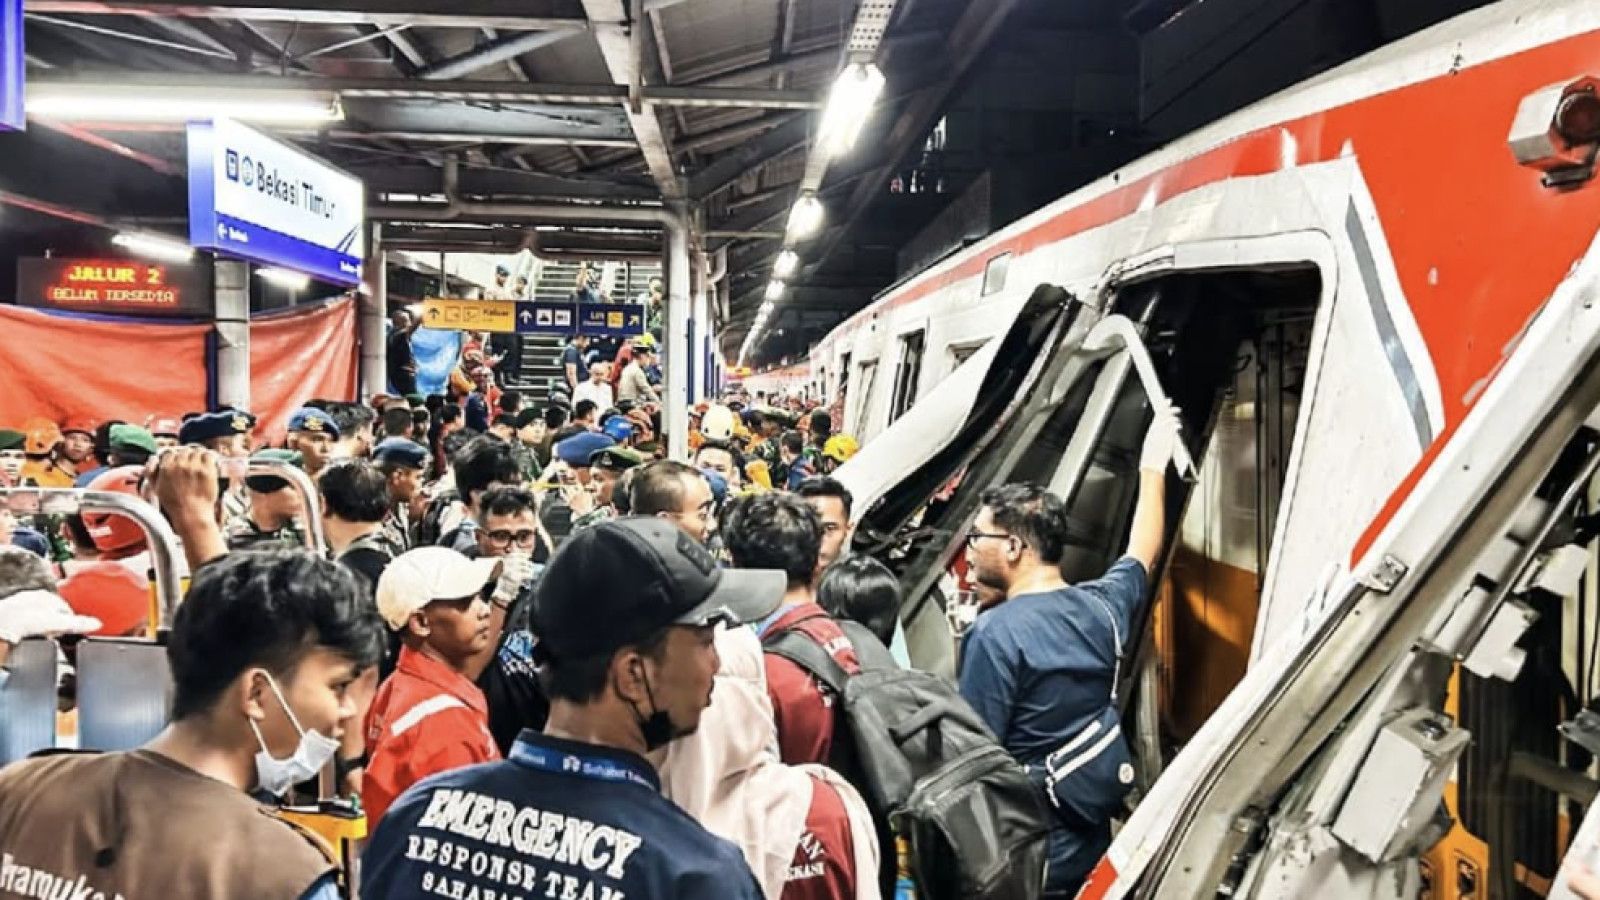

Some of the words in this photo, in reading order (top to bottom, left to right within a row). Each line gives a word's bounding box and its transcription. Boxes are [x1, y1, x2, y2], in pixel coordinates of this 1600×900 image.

[257, 160, 300, 207] Bekasi
[302, 181, 336, 221] Timur
[53, 287, 98, 301] BELUM
[106, 289, 175, 302] TERSEDIA
[68, 265, 135, 283] JALUR
[147, 267, 161, 283] 2
[416, 789, 642, 879] EMERGENCY
[405, 834, 536, 892] RESPONSE
[543, 870, 626, 900] TEAM
